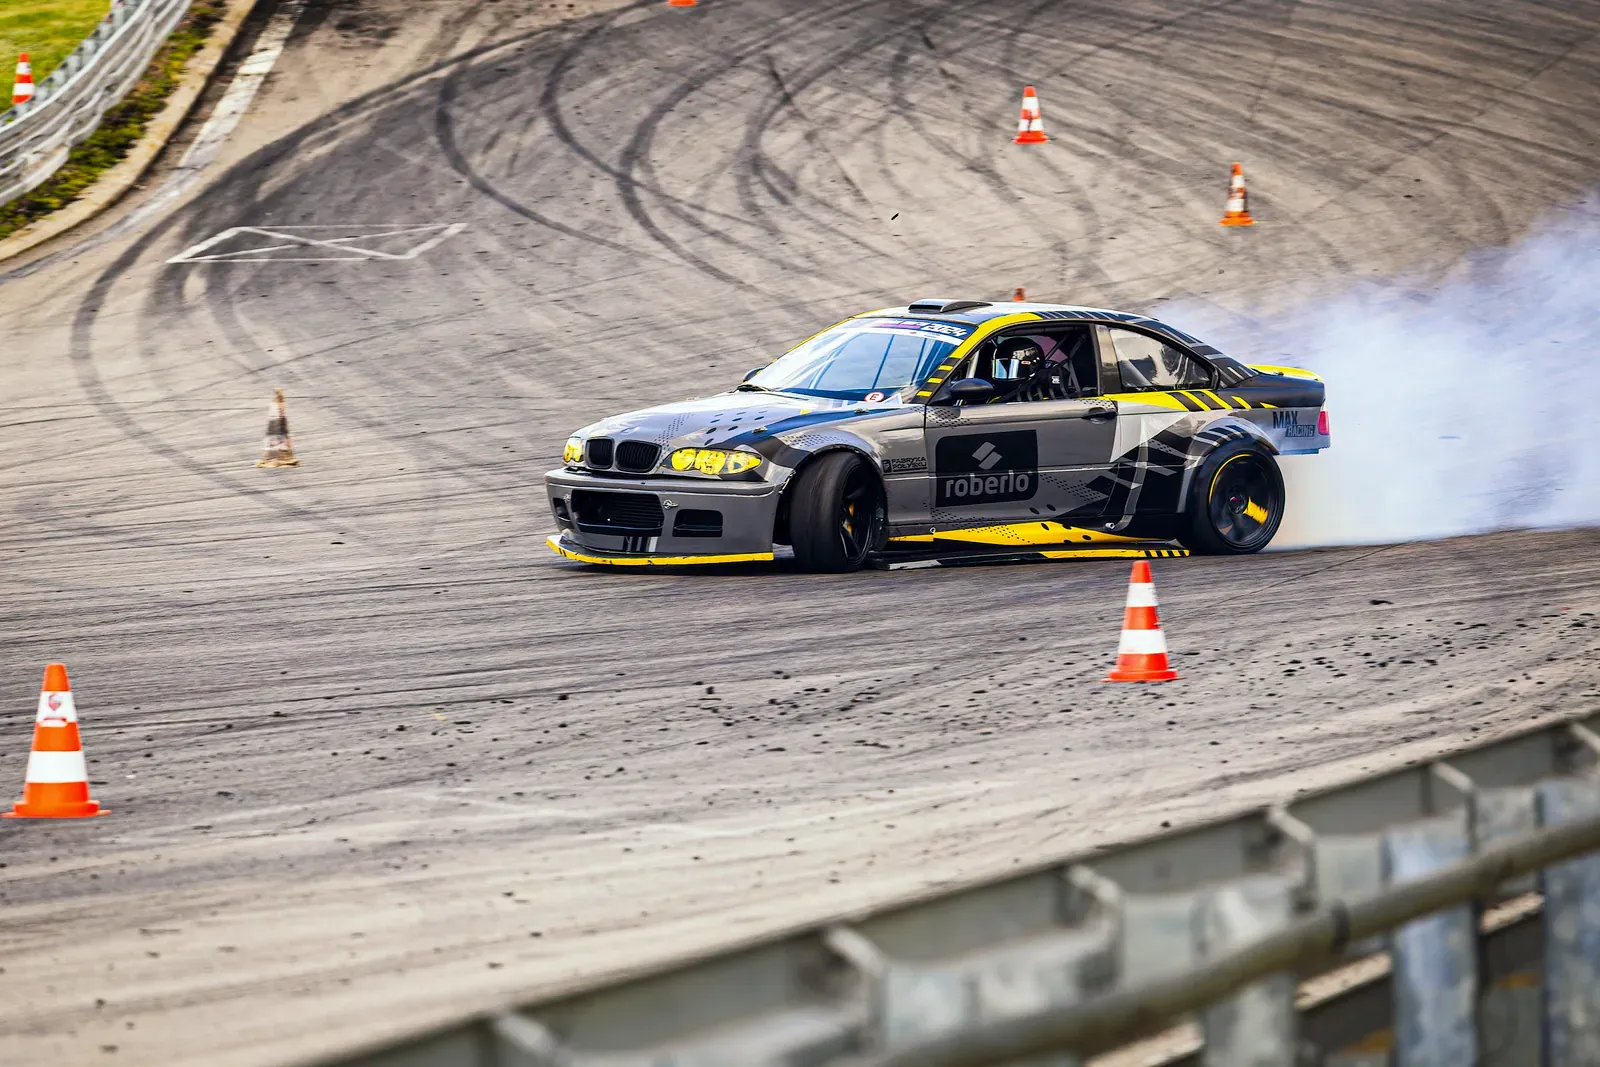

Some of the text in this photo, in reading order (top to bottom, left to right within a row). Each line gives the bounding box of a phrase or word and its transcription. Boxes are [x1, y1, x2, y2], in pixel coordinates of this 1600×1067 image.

[1273, 411, 1298, 428] MAX
[1287, 425, 1314, 437] RACING
[892, 456, 926, 464] FABRYKA
[945, 470, 1030, 498] roberlo
